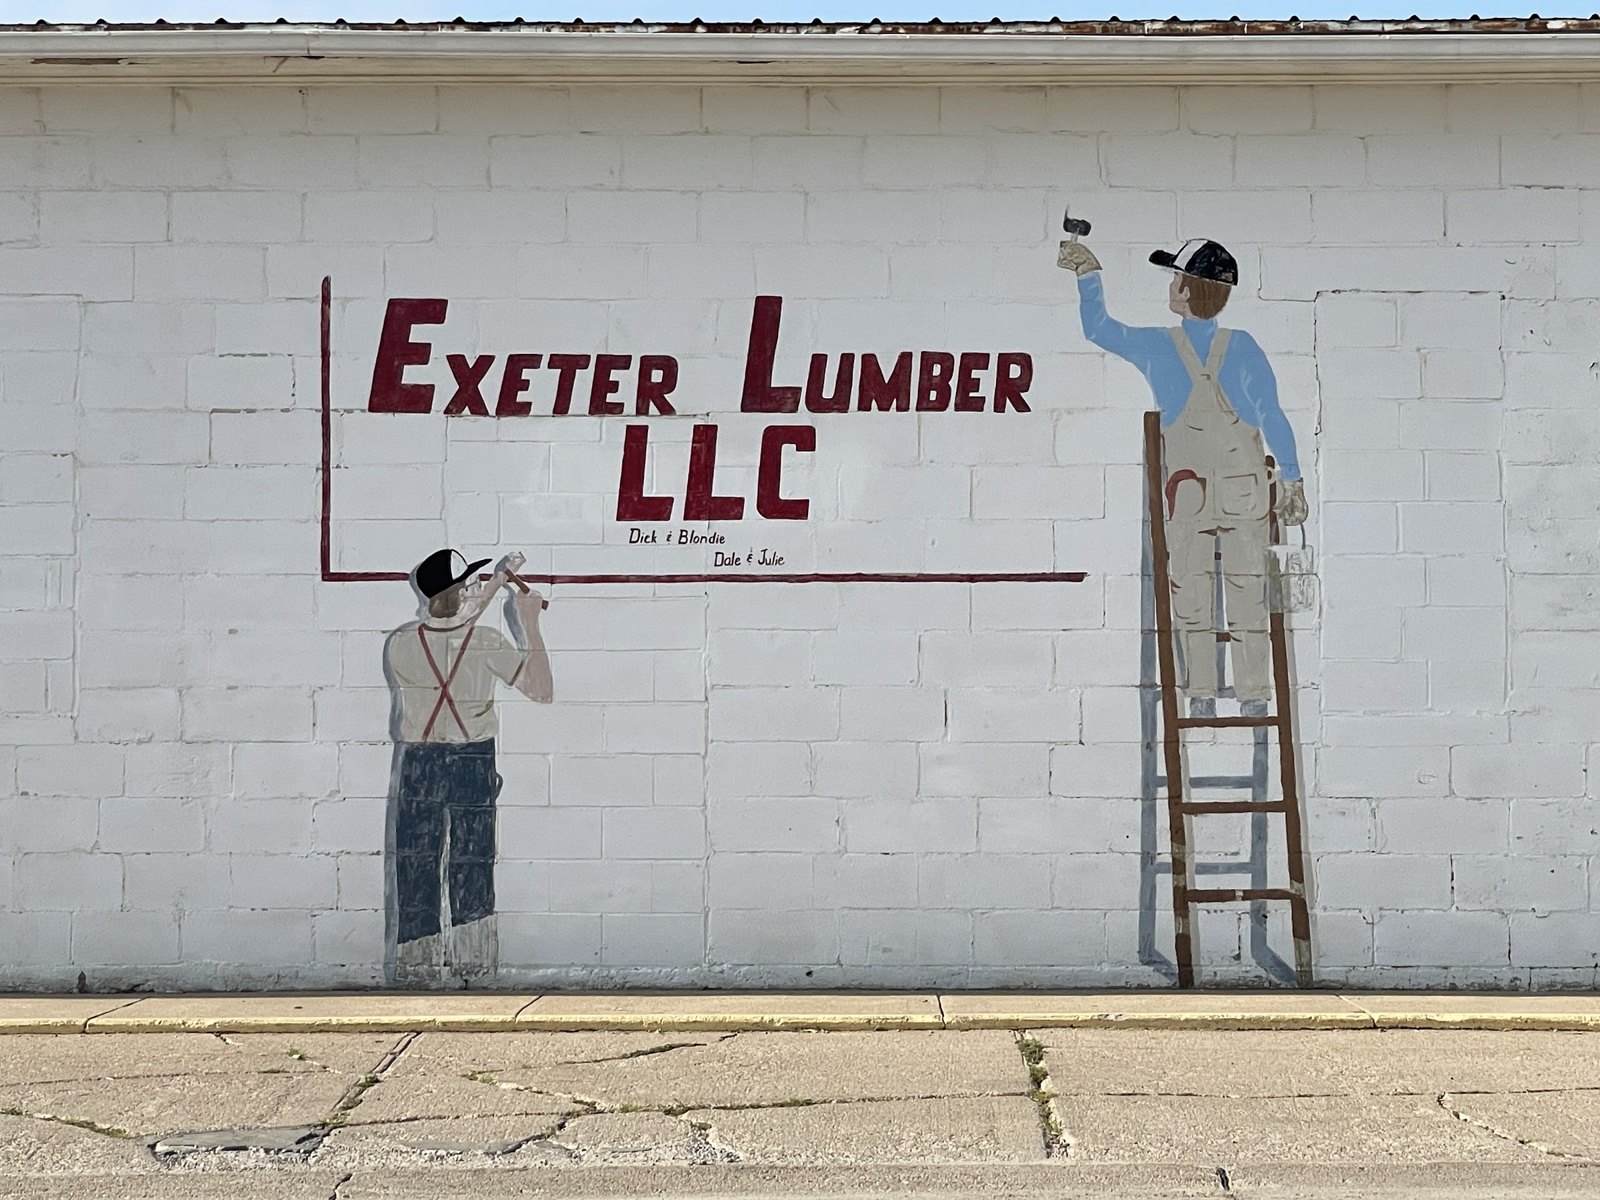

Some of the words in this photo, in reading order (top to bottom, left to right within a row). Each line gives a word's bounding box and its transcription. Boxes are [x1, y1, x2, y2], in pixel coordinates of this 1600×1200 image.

[368, 298, 678, 416] EXETER
[741, 295, 1032, 413] LUMBER
[616, 425, 816, 521] LLC
[628, 528, 657, 544] Dick
[678, 529, 726, 544] Blondie
[714, 551, 741, 567] Dale
[757, 549, 785, 567] Julie
